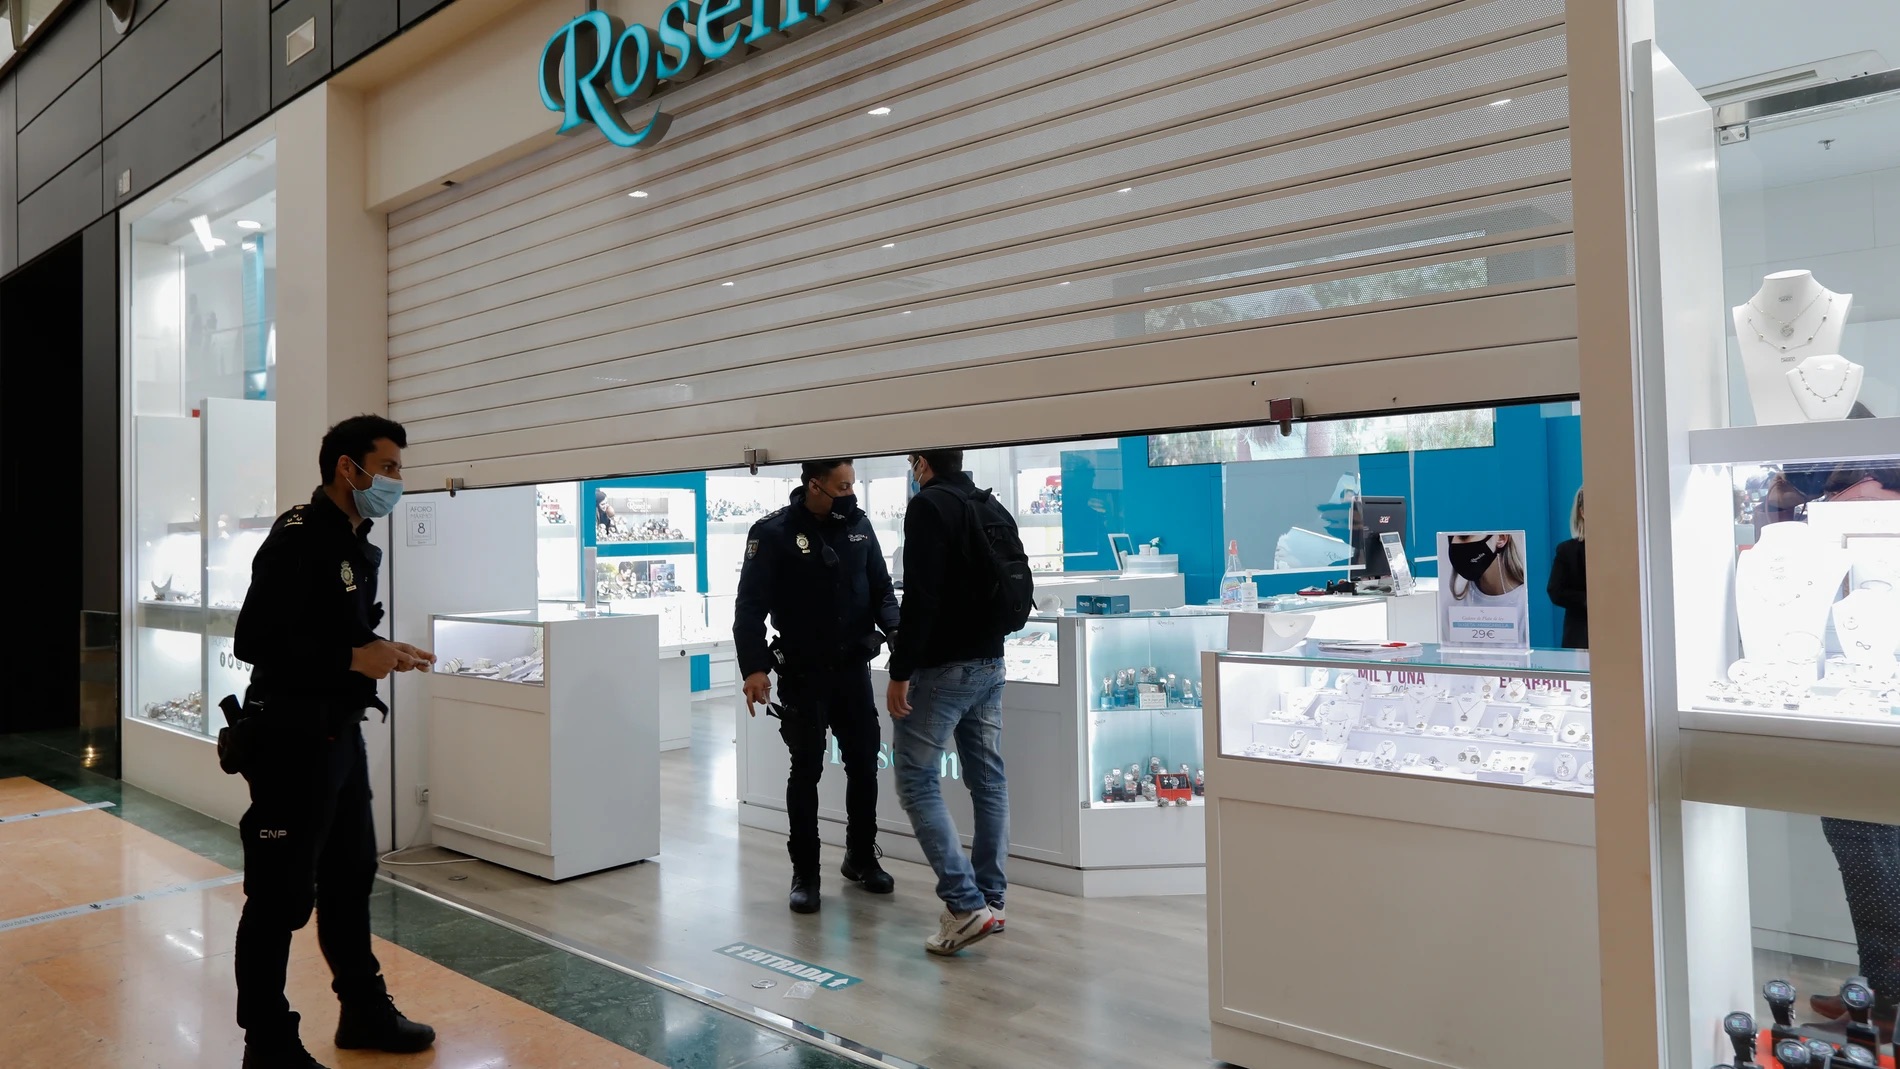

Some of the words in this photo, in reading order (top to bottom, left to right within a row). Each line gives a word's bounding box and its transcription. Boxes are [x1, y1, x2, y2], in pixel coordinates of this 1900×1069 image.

[417, 522, 426, 534] 8
[1472, 629, 1495, 639] 29€
[1358, 669, 1380, 682] MIL
[1386, 670, 1392, 683] Y
[1398, 671, 1426, 685] UNA
[259, 829, 287, 839] CNP
[736, 948, 835, 983] ENTRADA
